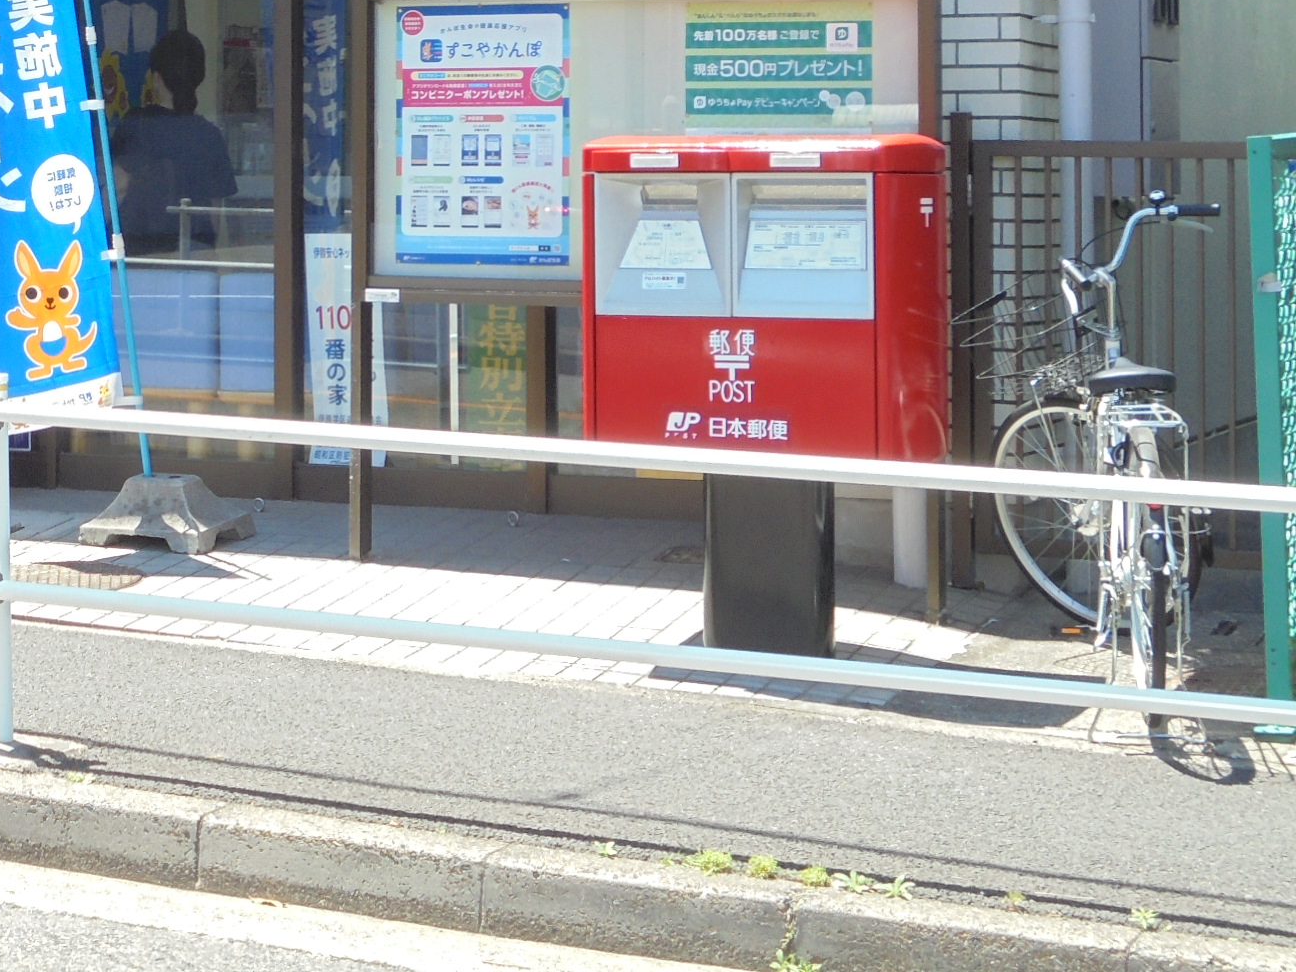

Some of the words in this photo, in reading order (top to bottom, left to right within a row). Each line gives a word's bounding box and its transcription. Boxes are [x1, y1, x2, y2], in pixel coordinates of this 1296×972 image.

[446, 39, 543, 59] すこやかんぽ
[693, 59, 863, 78] 現金500円プレゼント!
[410, 90, 524, 100] コンビニクーポンプレゼント!
[708, 96, 752, 109] ゆうちょPay
[709, 329, 755, 356] 郵便
[708, 380, 755, 403] POST
[708, 417, 789, 441] 日本郵便
